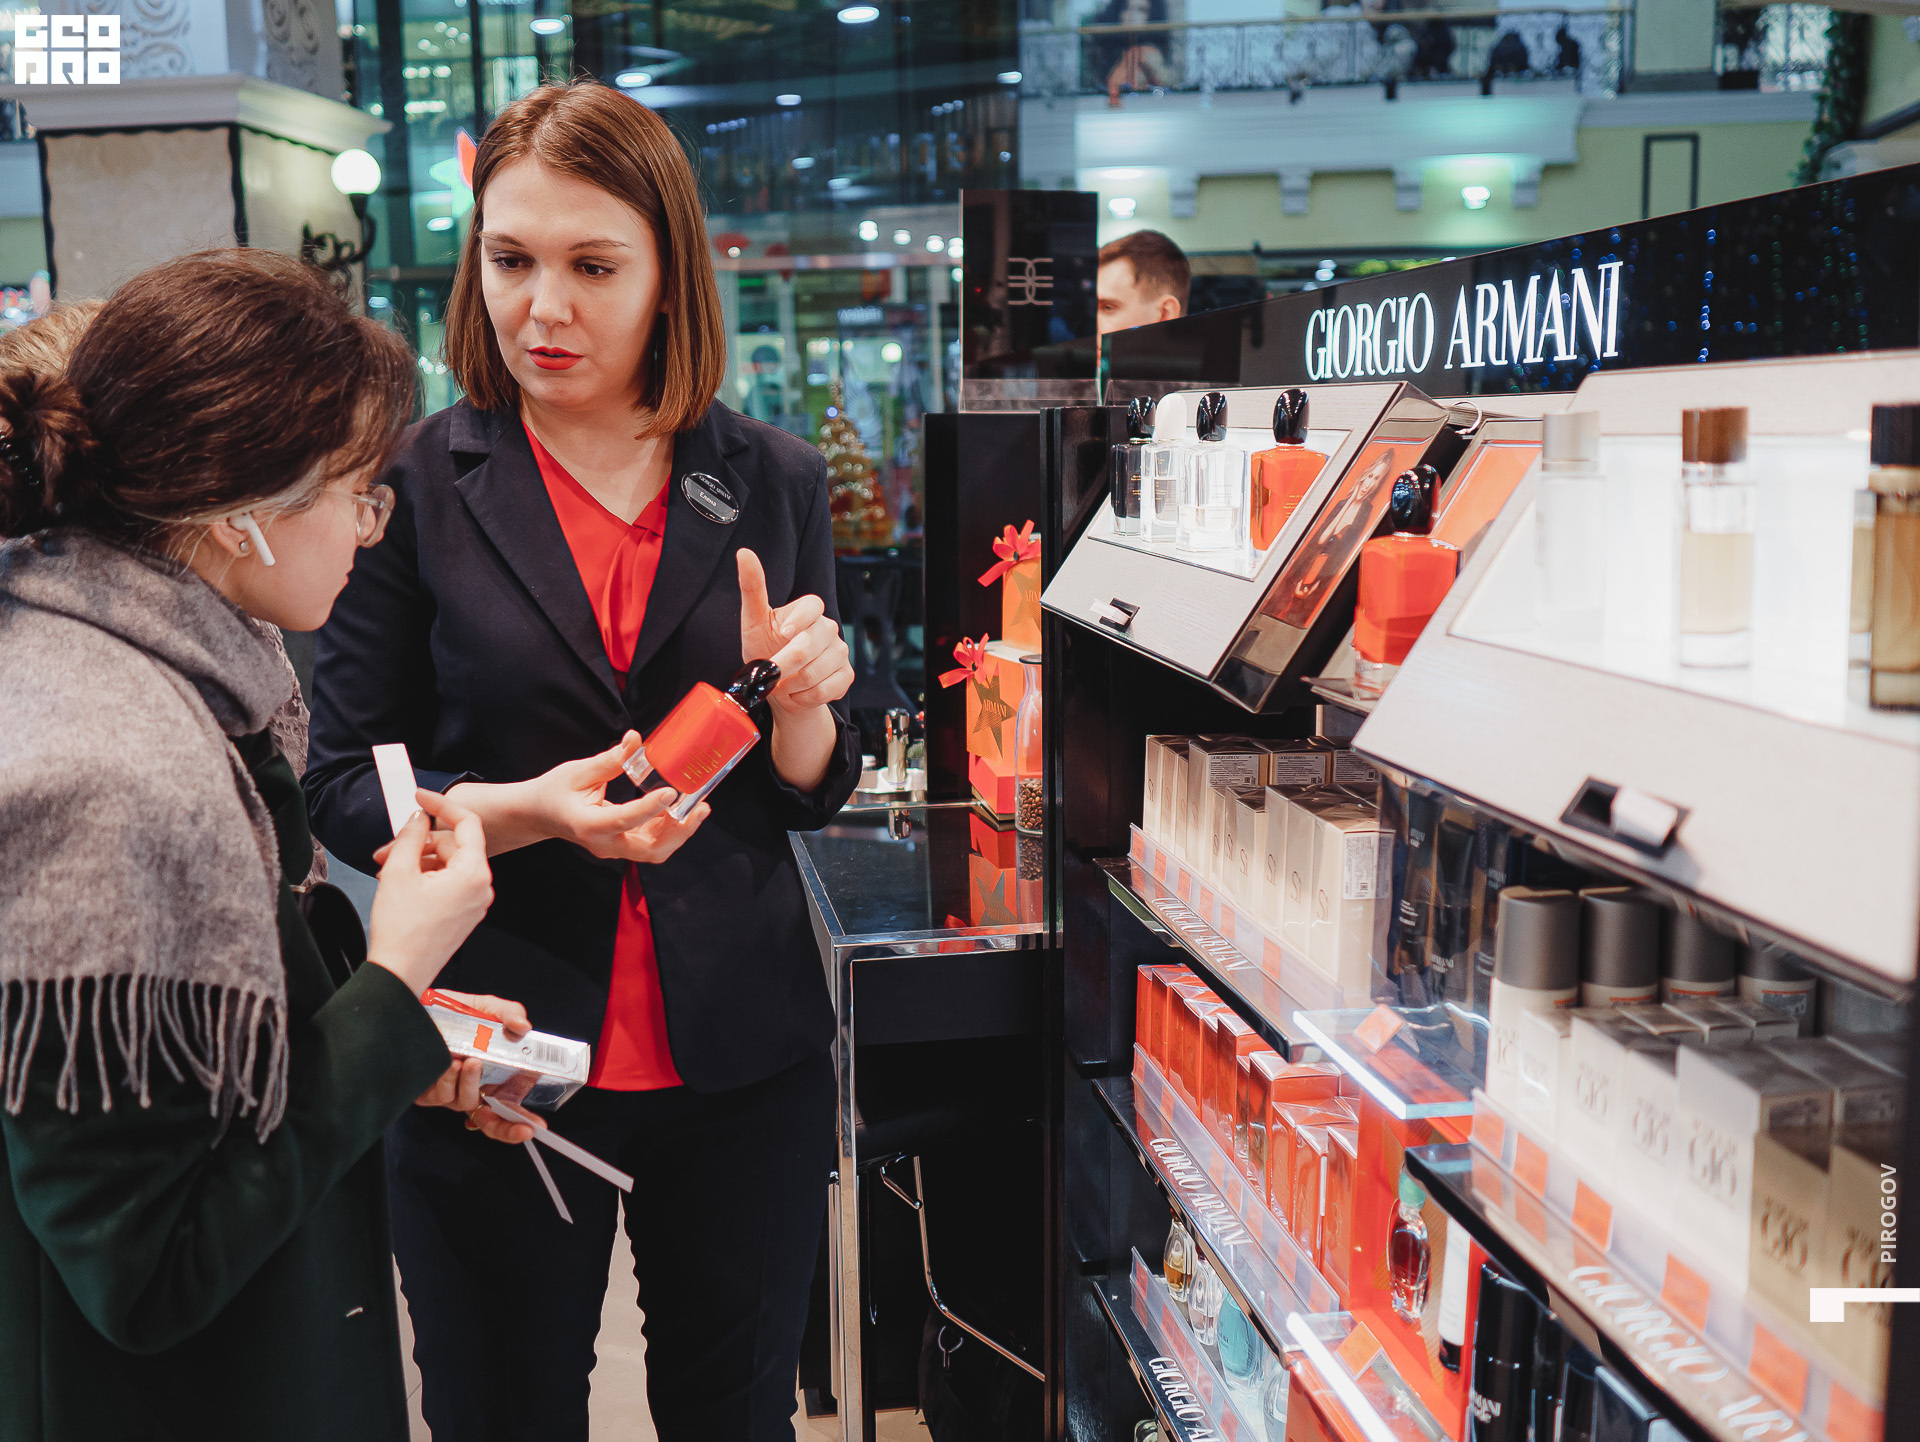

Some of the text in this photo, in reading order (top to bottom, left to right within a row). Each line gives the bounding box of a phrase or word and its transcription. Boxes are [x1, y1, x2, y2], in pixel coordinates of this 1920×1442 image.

[1305, 261, 1624, 381] GIORGIO ARMANI
[699, 491, 717, 507] Елена
[983, 698, 1007, 718] ARMANI
[1151, 897, 1211, 932] GIORGIO
[1149, 1137, 1209, 1189] GIORGIO
[1568, 1265, 1730, 1383] GIORGIO
[1148, 1356, 1206, 1422] GIORGIO
